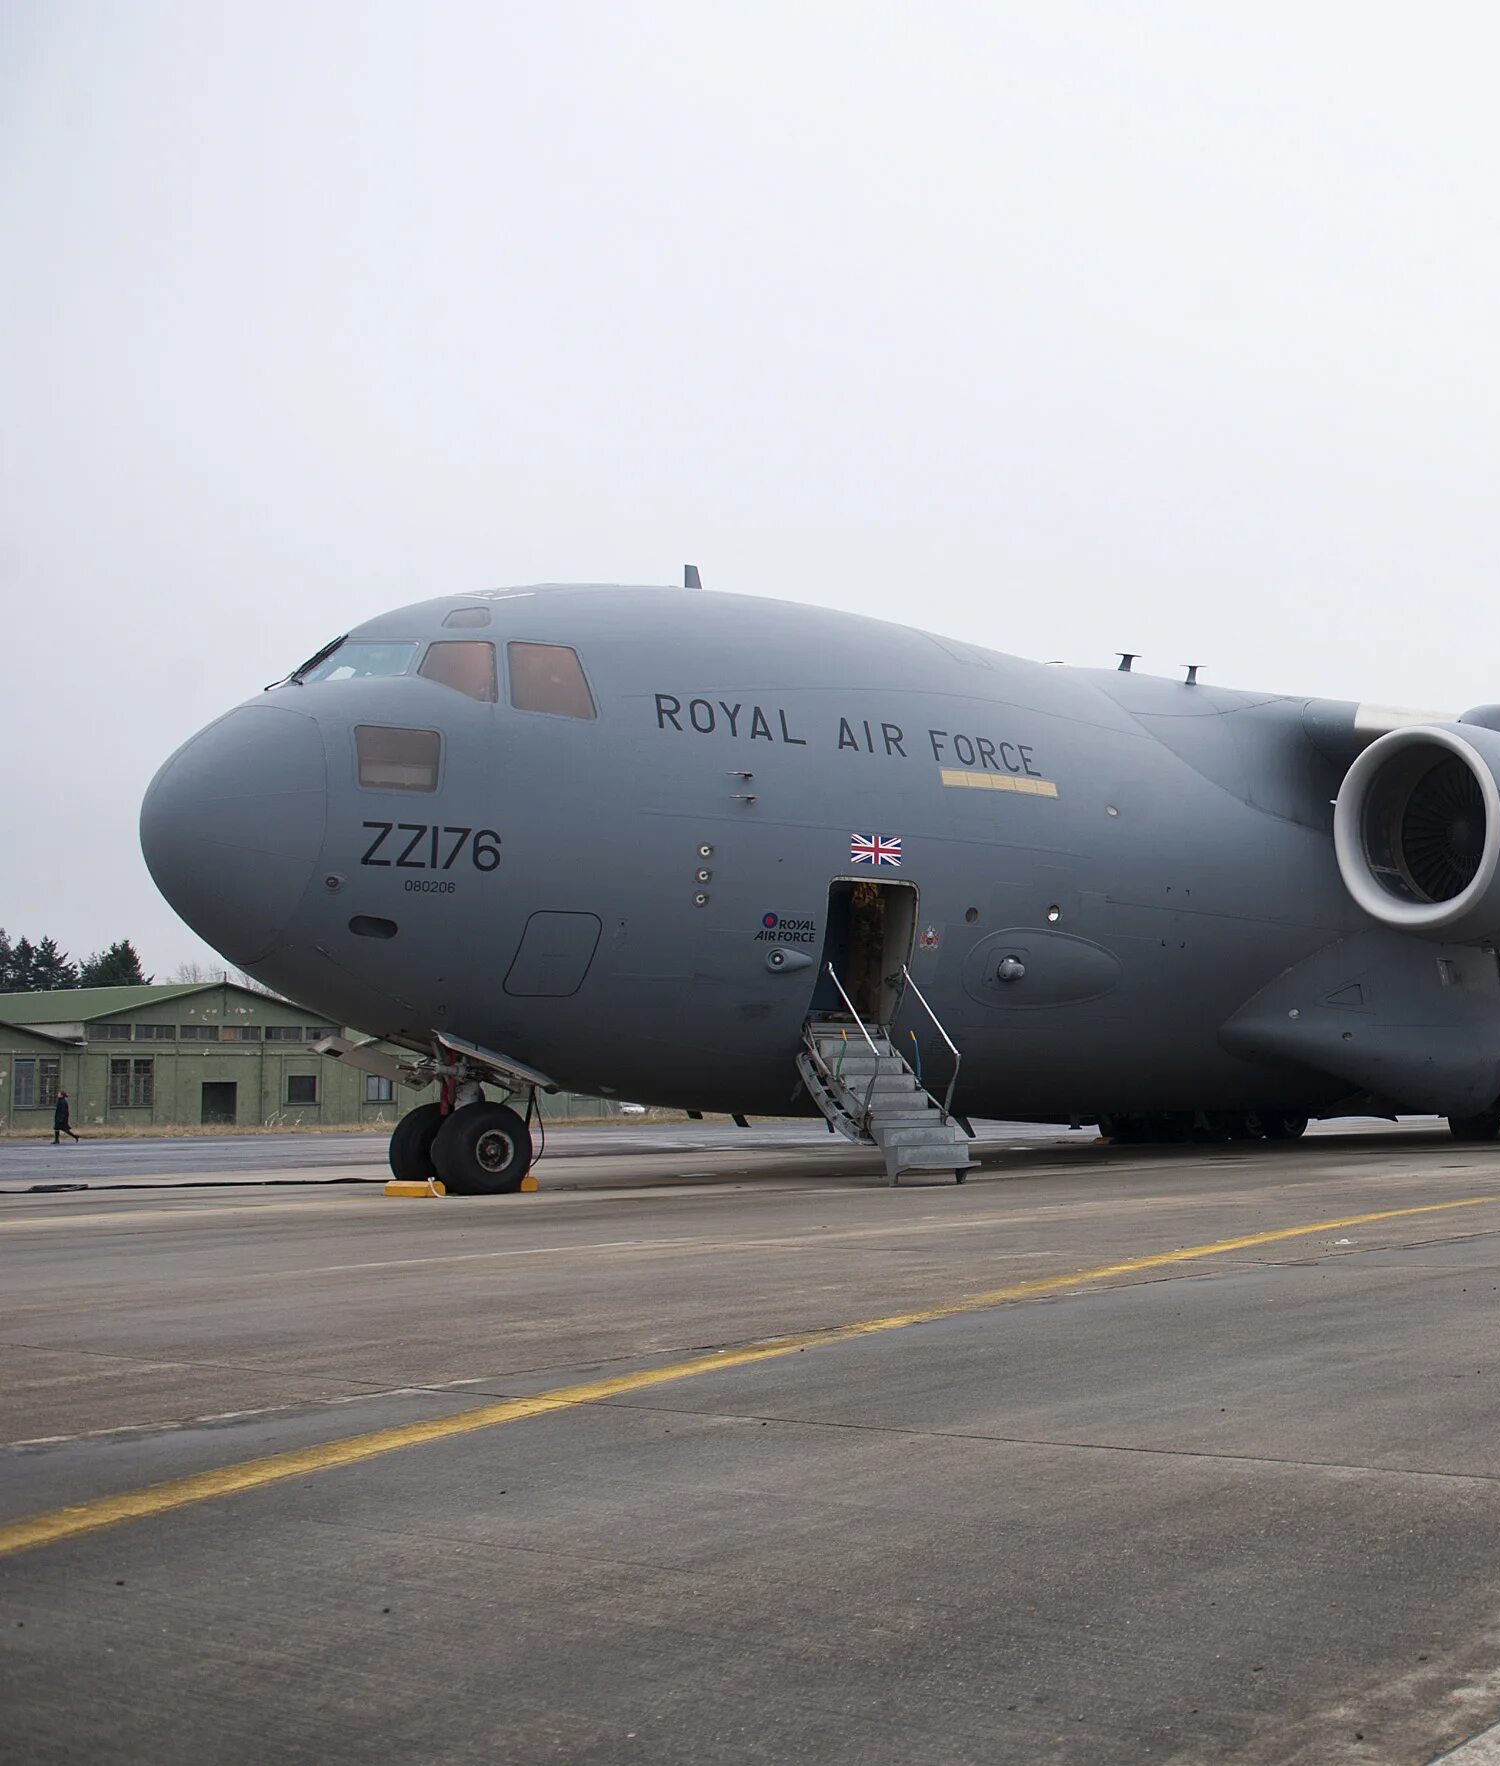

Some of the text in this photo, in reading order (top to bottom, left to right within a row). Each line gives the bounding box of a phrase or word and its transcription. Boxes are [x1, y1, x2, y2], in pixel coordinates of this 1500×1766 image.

[654, 693, 1042, 777] ROYAL AIR FORCE
[360, 821, 502, 872] ZZ176
[404, 879, 456, 894] 080206
[779, 919, 815, 930] ROYAL
[754, 930, 815, 942] AIR FORCE
